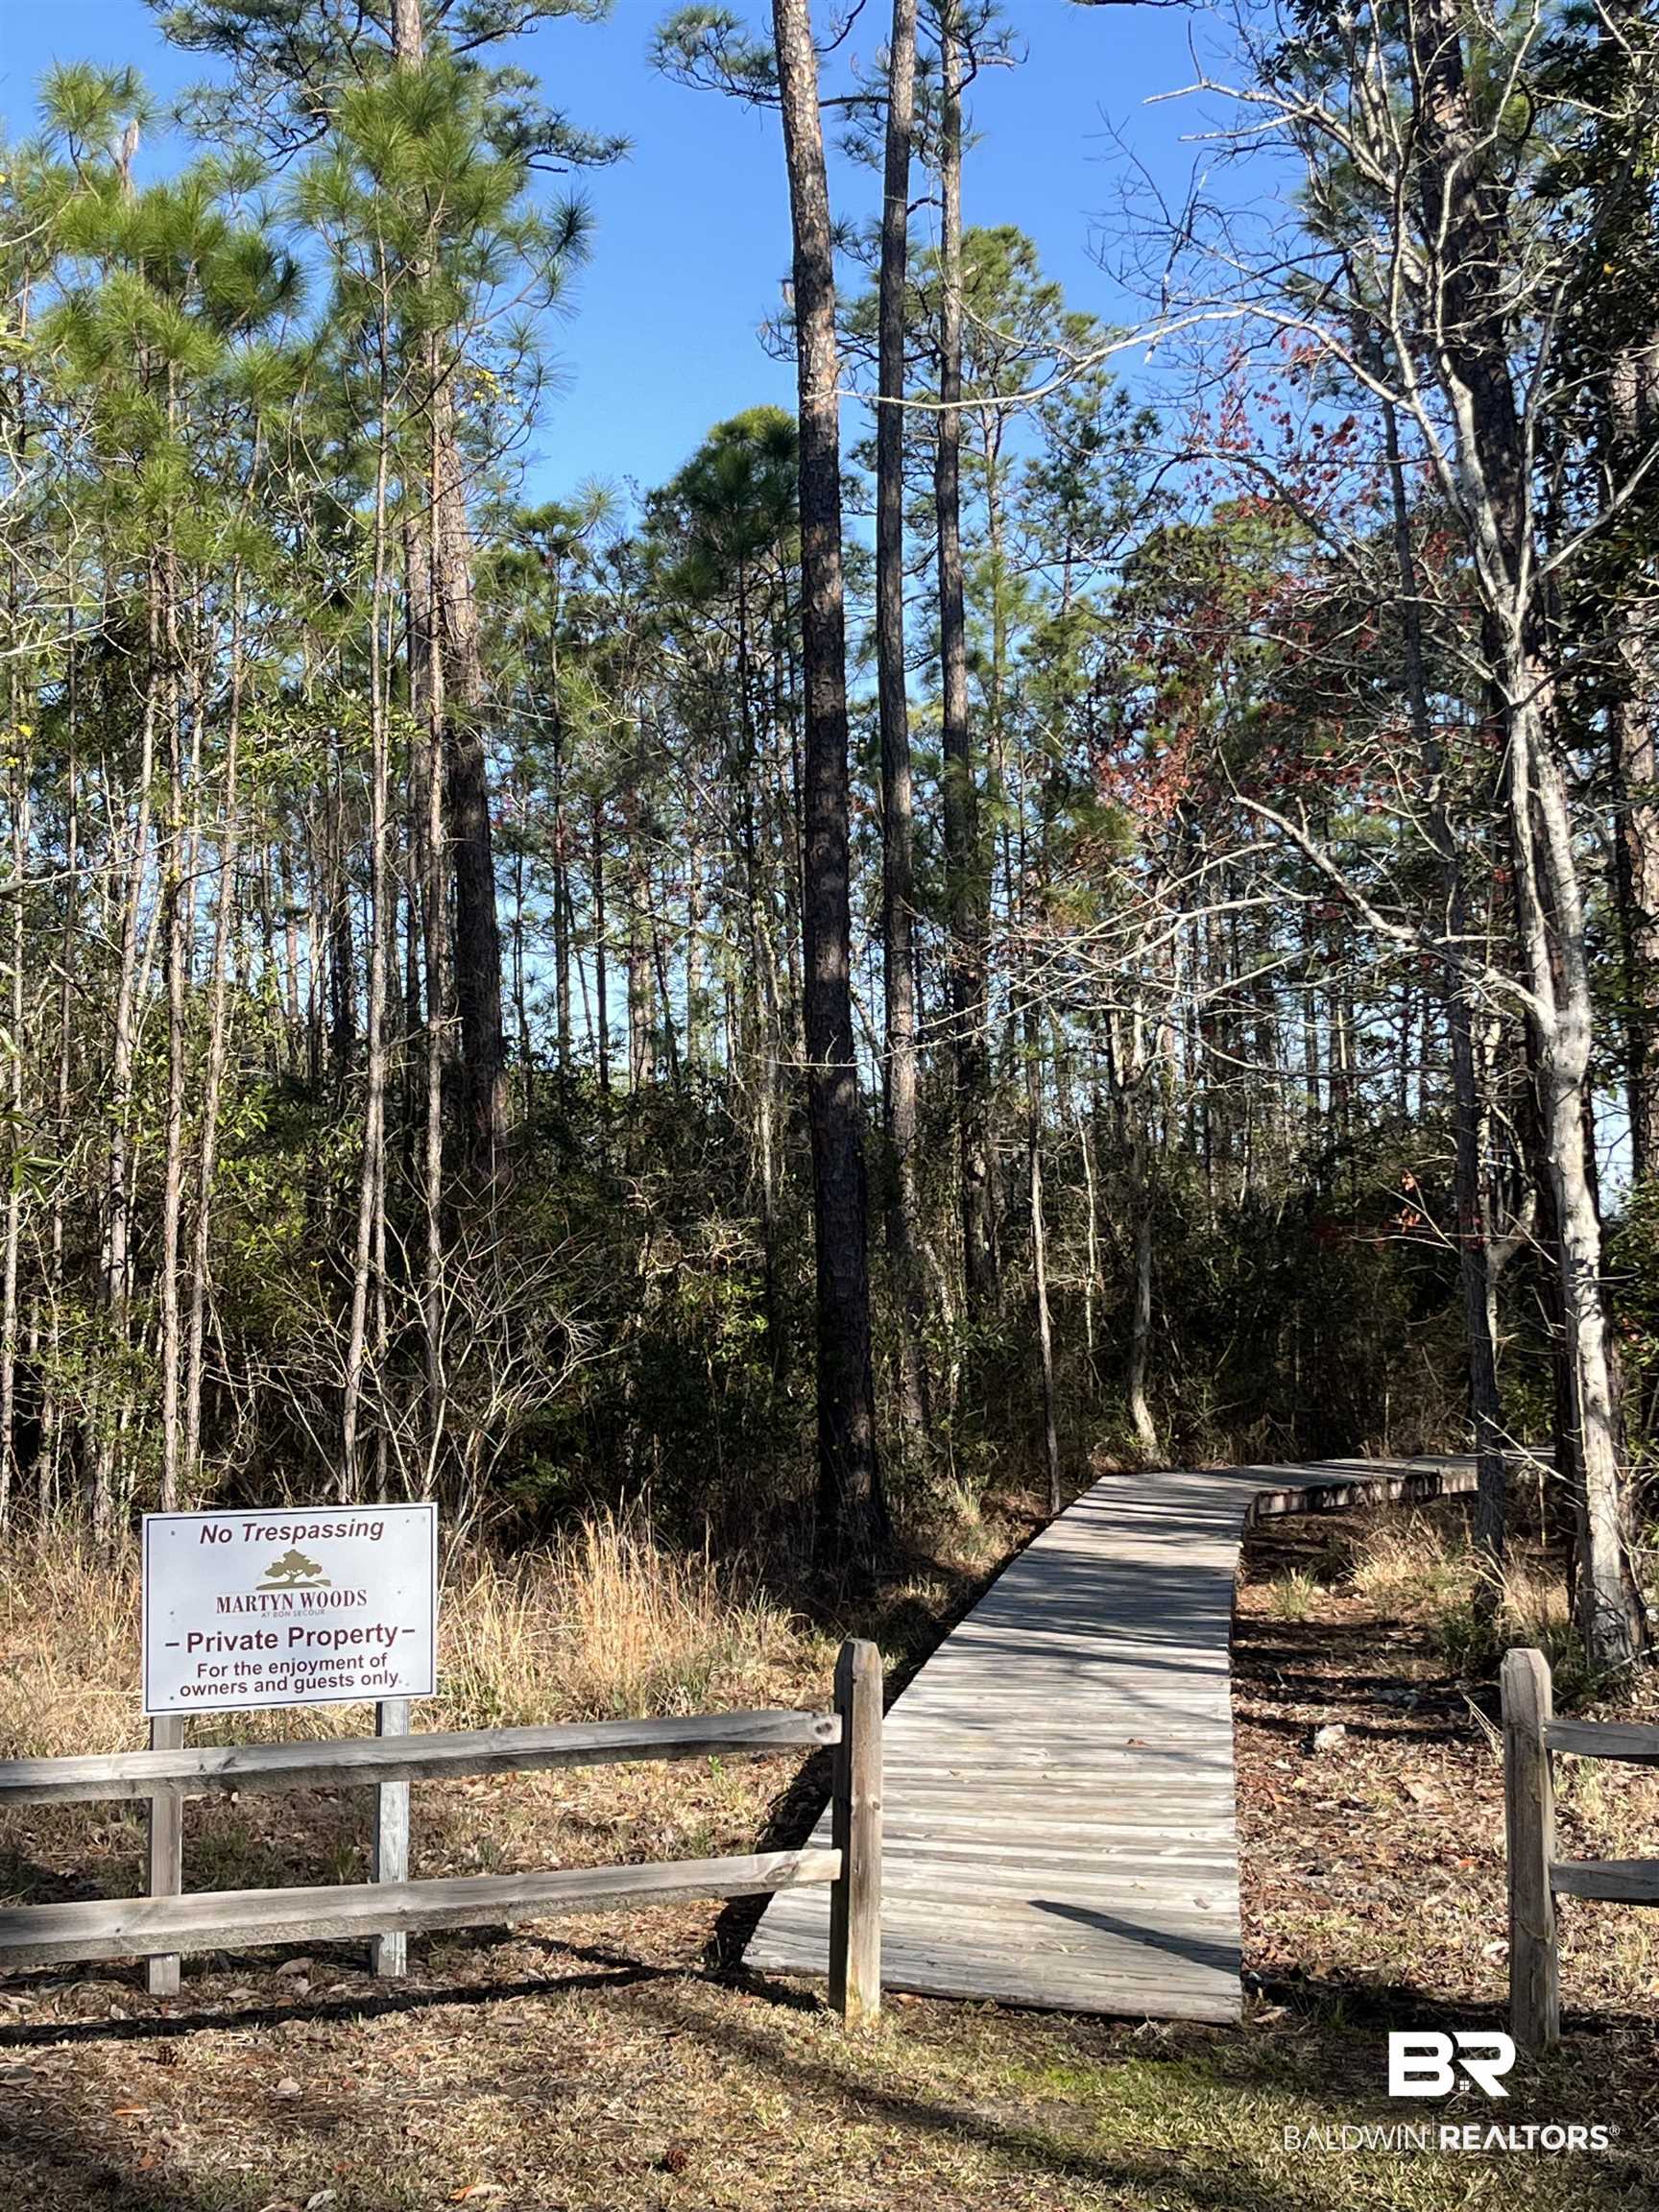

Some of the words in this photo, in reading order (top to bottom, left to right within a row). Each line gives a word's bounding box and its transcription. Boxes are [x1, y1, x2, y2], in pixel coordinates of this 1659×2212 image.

[200, 1525, 232, 1544] No
[242, 1518, 385, 1544] Trespassing
[216, 1592, 294, 1614] MARTYN
[300, 1589, 368, 1609] WOODS
[197, 1663, 228, 1678] For
[234, 1660, 262, 1676] the
[268, 1656, 364, 1678] enjoyment
[370, 1652, 388, 1668] of
[180, 1680, 248, 1697] owners
[253, 1675, 288, 1693] and
[294, 1672, 355, 1695] guests
